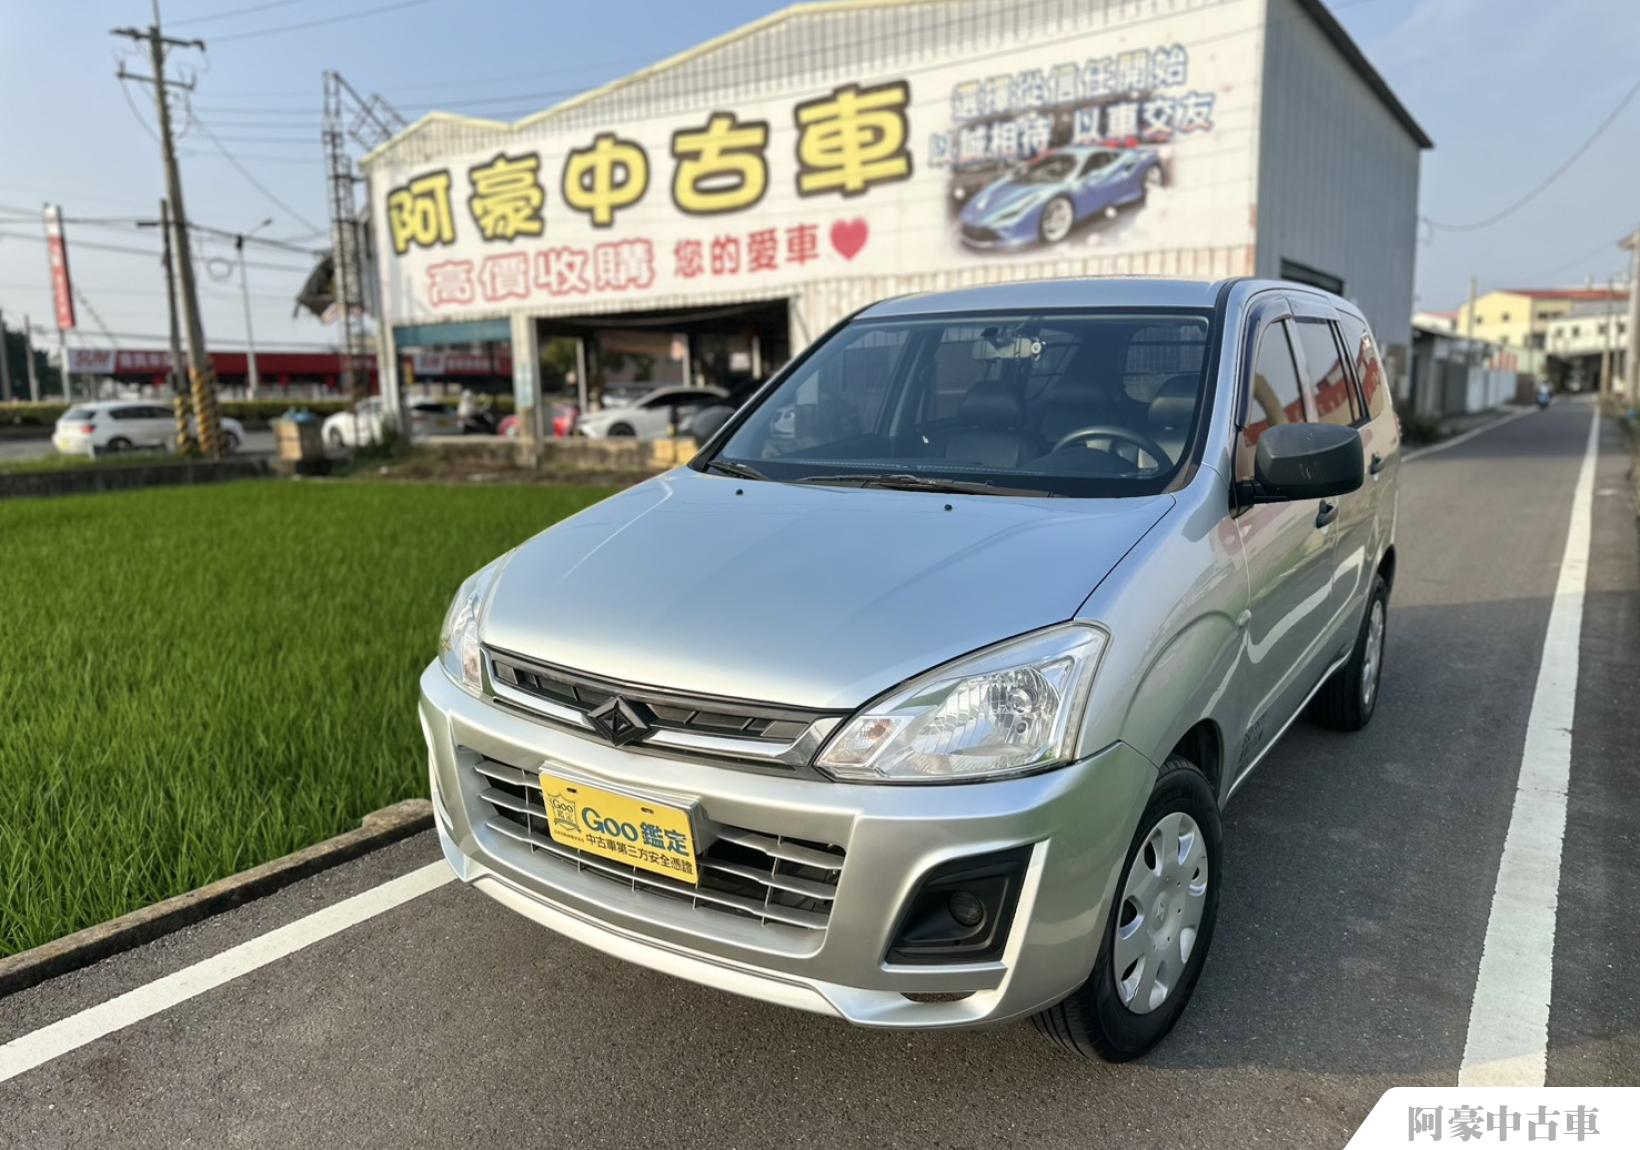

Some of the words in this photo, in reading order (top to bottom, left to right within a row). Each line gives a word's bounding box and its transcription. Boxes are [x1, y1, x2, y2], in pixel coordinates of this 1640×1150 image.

[387, 80, 913, 254] 阿豪中古車
[426, 238, 655, 307] 高價收購
[673, 223, 820, 278] 您的愛車
[581, 806, 639, 843] Goo
[640, 820, 690, 857] 鑑定
